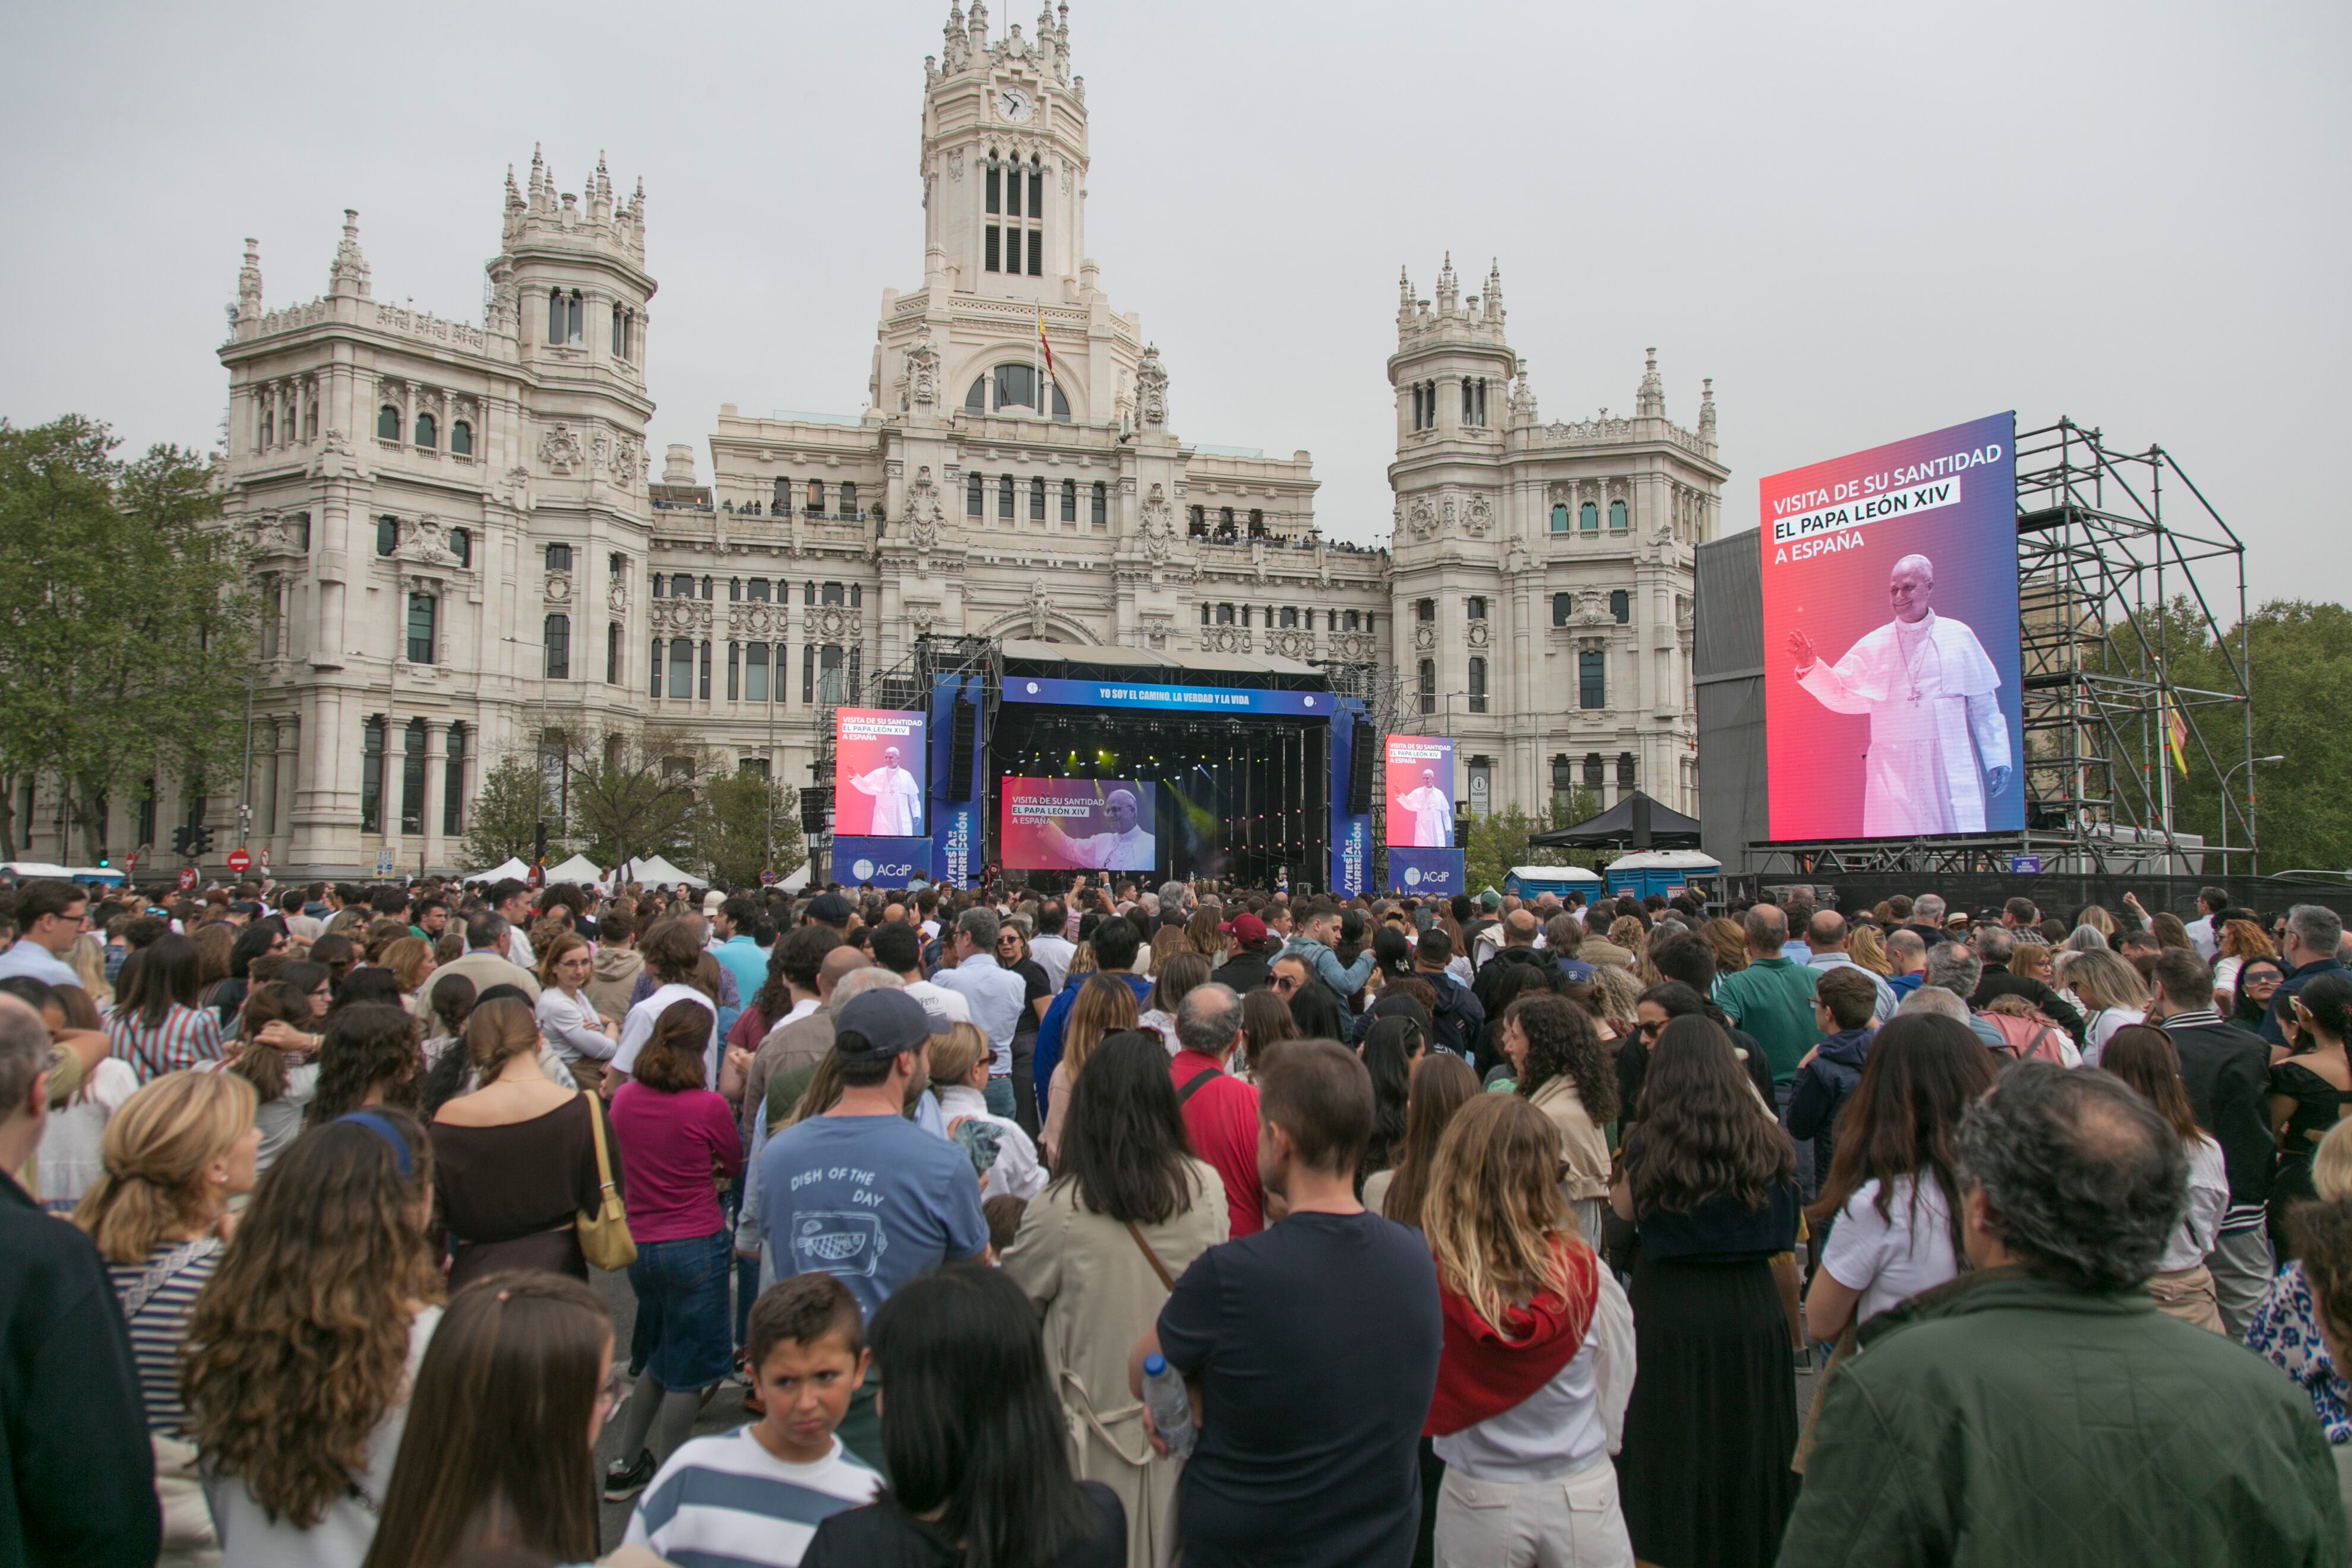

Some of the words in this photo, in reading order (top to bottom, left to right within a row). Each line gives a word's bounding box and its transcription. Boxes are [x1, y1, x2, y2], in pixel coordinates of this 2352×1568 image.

[1774, 488, 1830, 515] VISITA
[1834, 479, 1860, 501] DE
[1863, 472, 1889, 494] SU
[1893, 444, 2002, 487] SANTIDAD
[1775, 523, 1795, 539] EL
[1801, 509, 1849, 533] PAPA
[1855, 494, 1908, 521] LEÓN
[1914, 483, 1950, 508] XIV
[1775, 548, 1788, 565] A
[1791, 529, 1864, 561] ESPAÑA
[1100, 688, 1110, 698] YO
[1112, 689, 1128, 699] SOY
[1129, 690, 1137, 700] EL
[1139, 691, 1171, 702] CAMINO,
[1173, 693, 1182, 701] LA
[1183, 693, 1213, 703] VERDAD
[1215, 694, 1220, 704] Y
[1221, 695, 1230, 704] LA
[1231, 695, 1249, 705] VIDA
[1048, 806, 1070, 815] LEÓN
[1064, 798, 1104, 806] SANTIDAD
[1020, 816, 1052, 825] ESPAÑA
[876, 864, 912, 876] ACdP
[1422, 871, 1449, 882] ACdP
[791, 1168, 823, 1191] DISH
[828, 1166, 848, 1181] OF
[849, 1168, 876, 1186] THE
[852, 1188, 885, 1207] DAY
